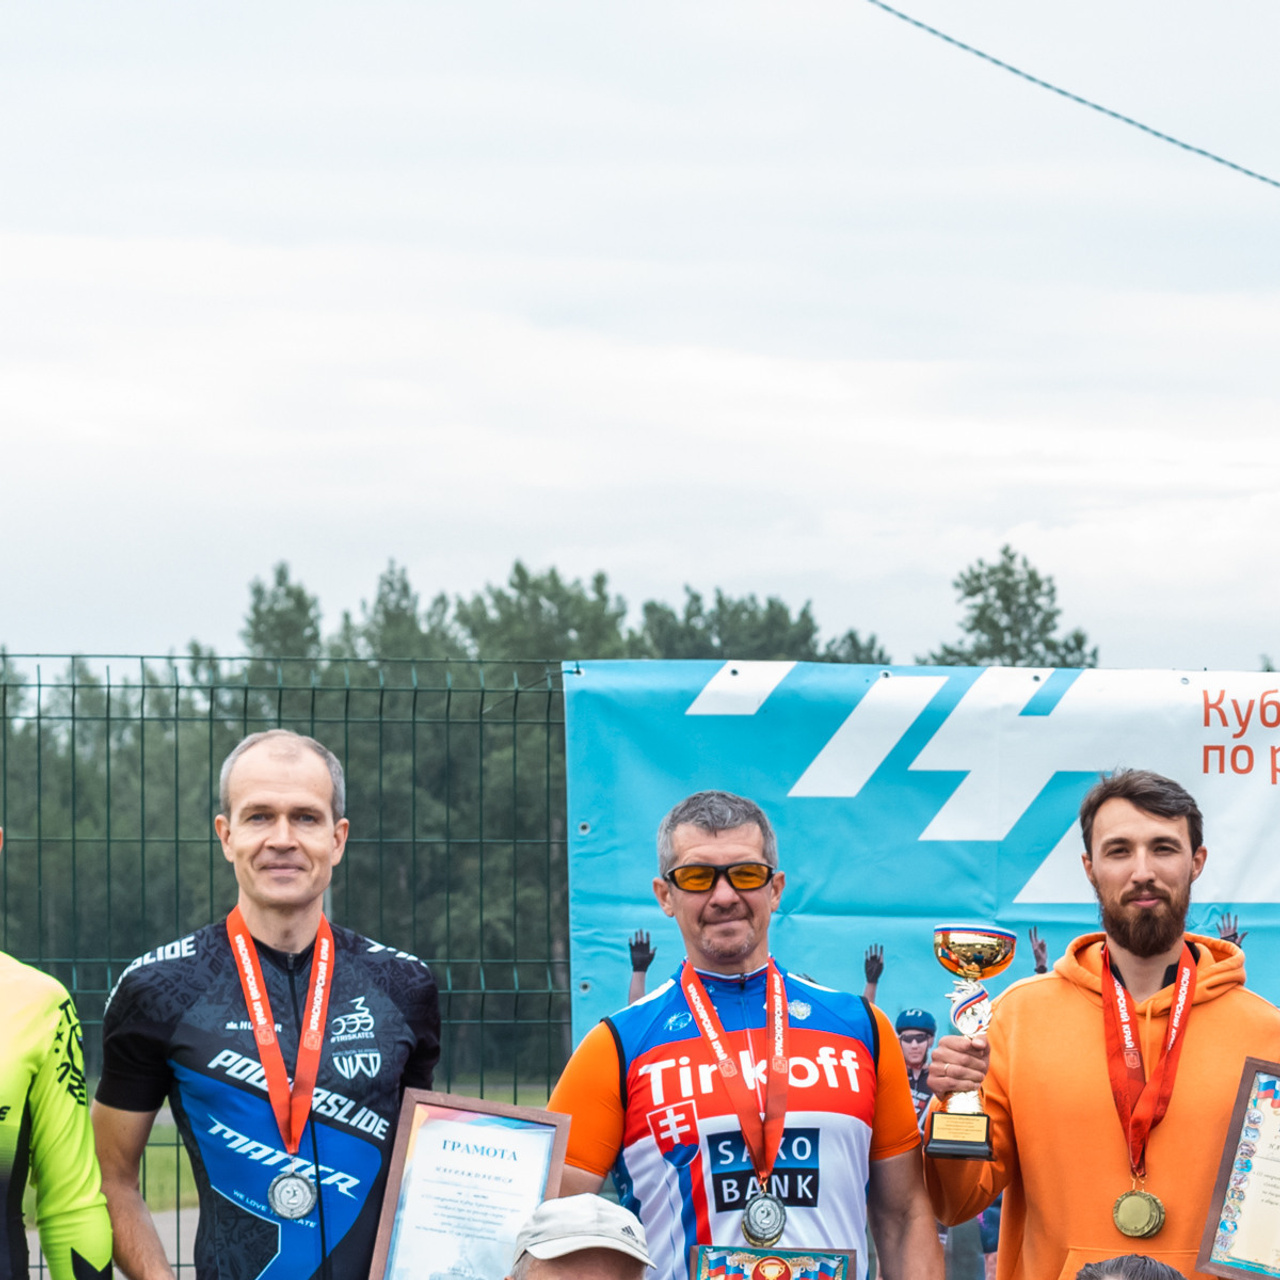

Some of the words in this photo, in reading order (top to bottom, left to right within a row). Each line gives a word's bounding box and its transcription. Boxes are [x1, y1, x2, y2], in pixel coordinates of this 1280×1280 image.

[1202, 744, 1254, 775] по
[1122, 1024, 1134, 1048] КРАЙ
[206, 1113, 363, 1201] MATTER
[442, 1139, 518, 1162] ГРАМОТА
[721, 1174, 814, 1204] BANK
[758, 1205, 772, 1226] 2
